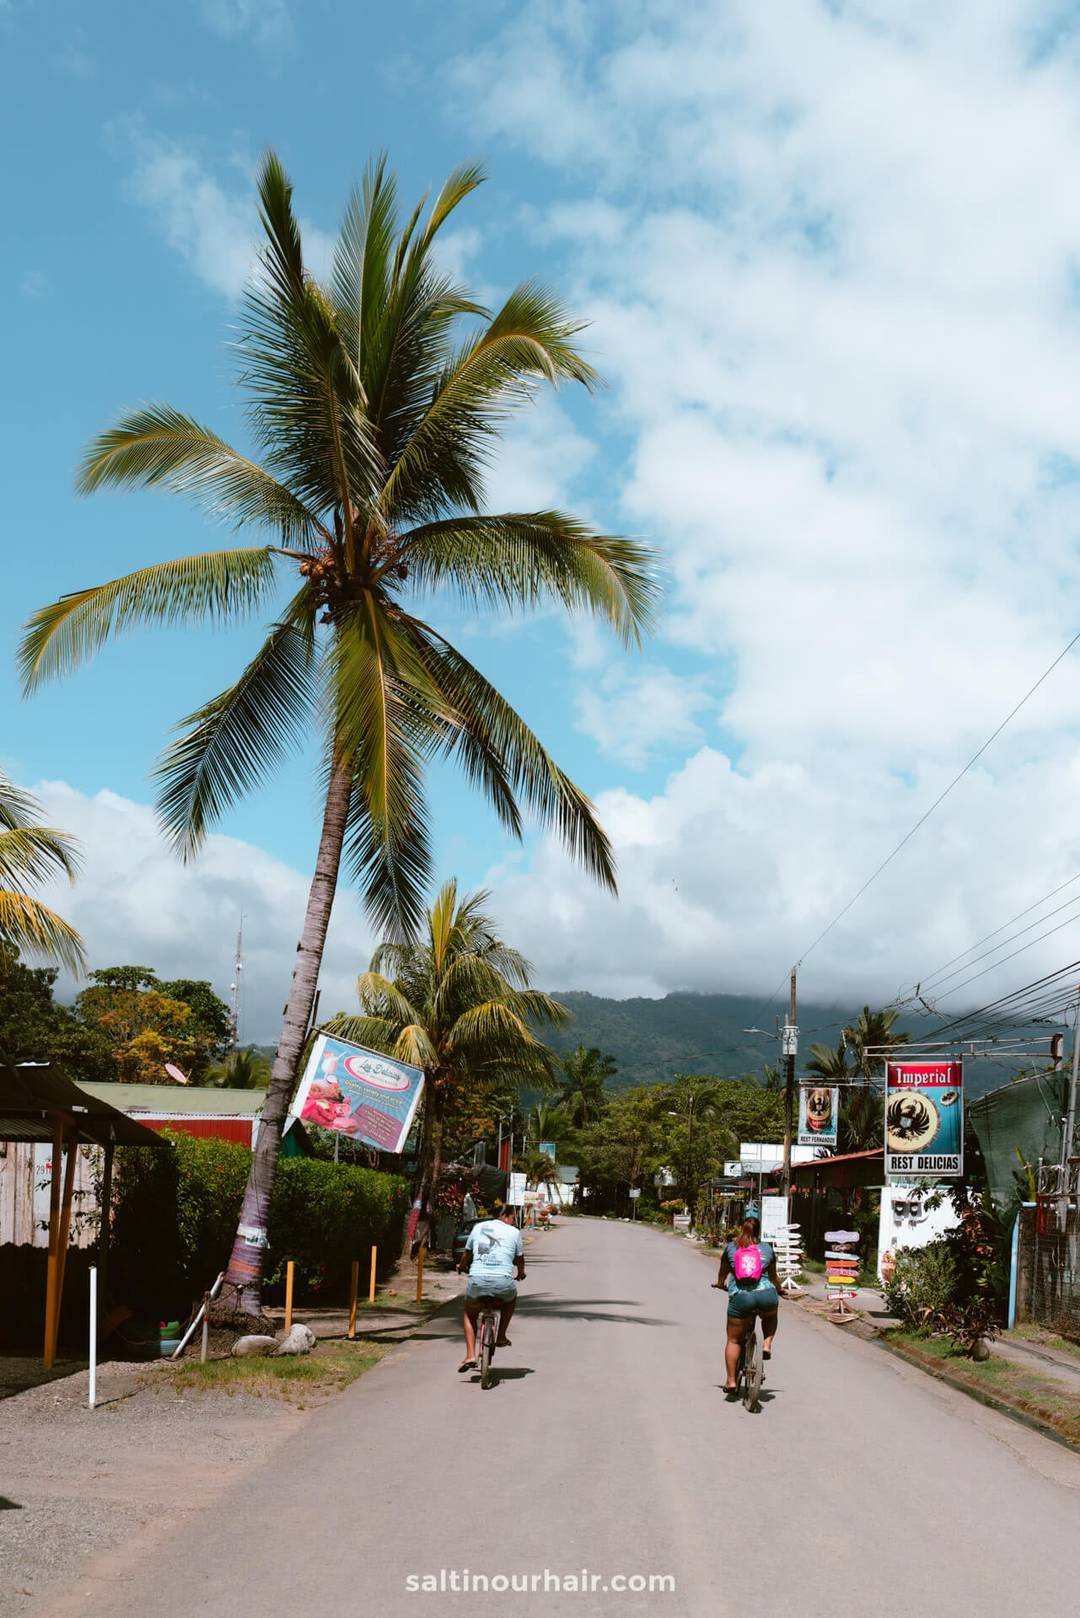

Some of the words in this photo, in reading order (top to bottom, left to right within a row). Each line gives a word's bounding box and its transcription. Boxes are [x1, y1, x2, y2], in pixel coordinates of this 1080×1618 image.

[896, 1067, 951, 1086] Imperial
[891, 1156, 914, 1170] REST
[917, 1156, 959, 1170] DELICIAS
